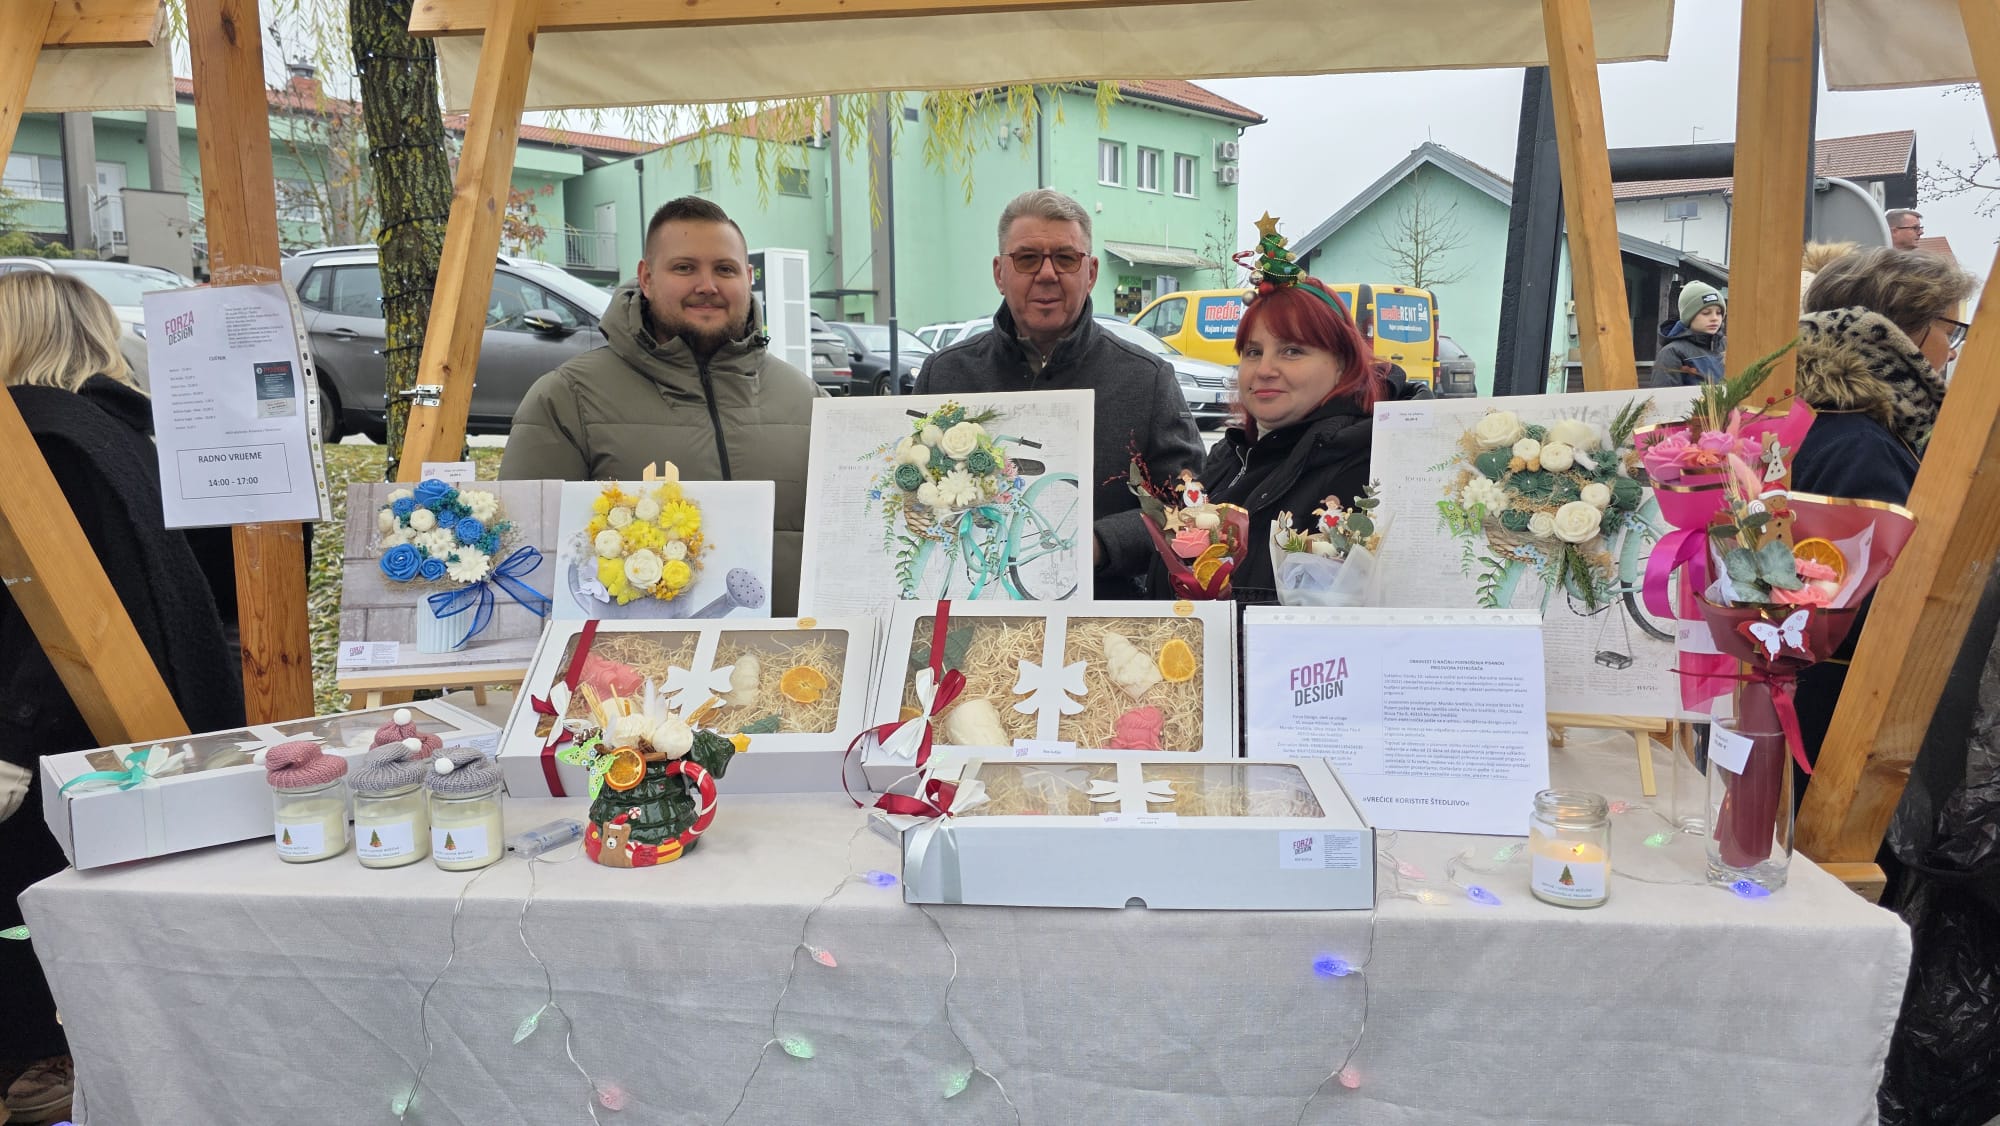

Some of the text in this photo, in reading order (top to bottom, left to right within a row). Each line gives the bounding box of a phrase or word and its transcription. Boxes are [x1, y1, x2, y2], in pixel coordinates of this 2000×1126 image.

[165, 310, 194, 336] FORZA
[169, 325, 193, 346] DESIGN
[198, 451, 262, 463] RADNO VRIJEME
[209, 478, 230, 487] 14:00
[237, 476, 259, 485] 17:00
[1290, 657, 1348, 691] FORZA
[1294, 680, 1344, 707] DESIGN
[1293, 838, 1312, 850] FORZA
